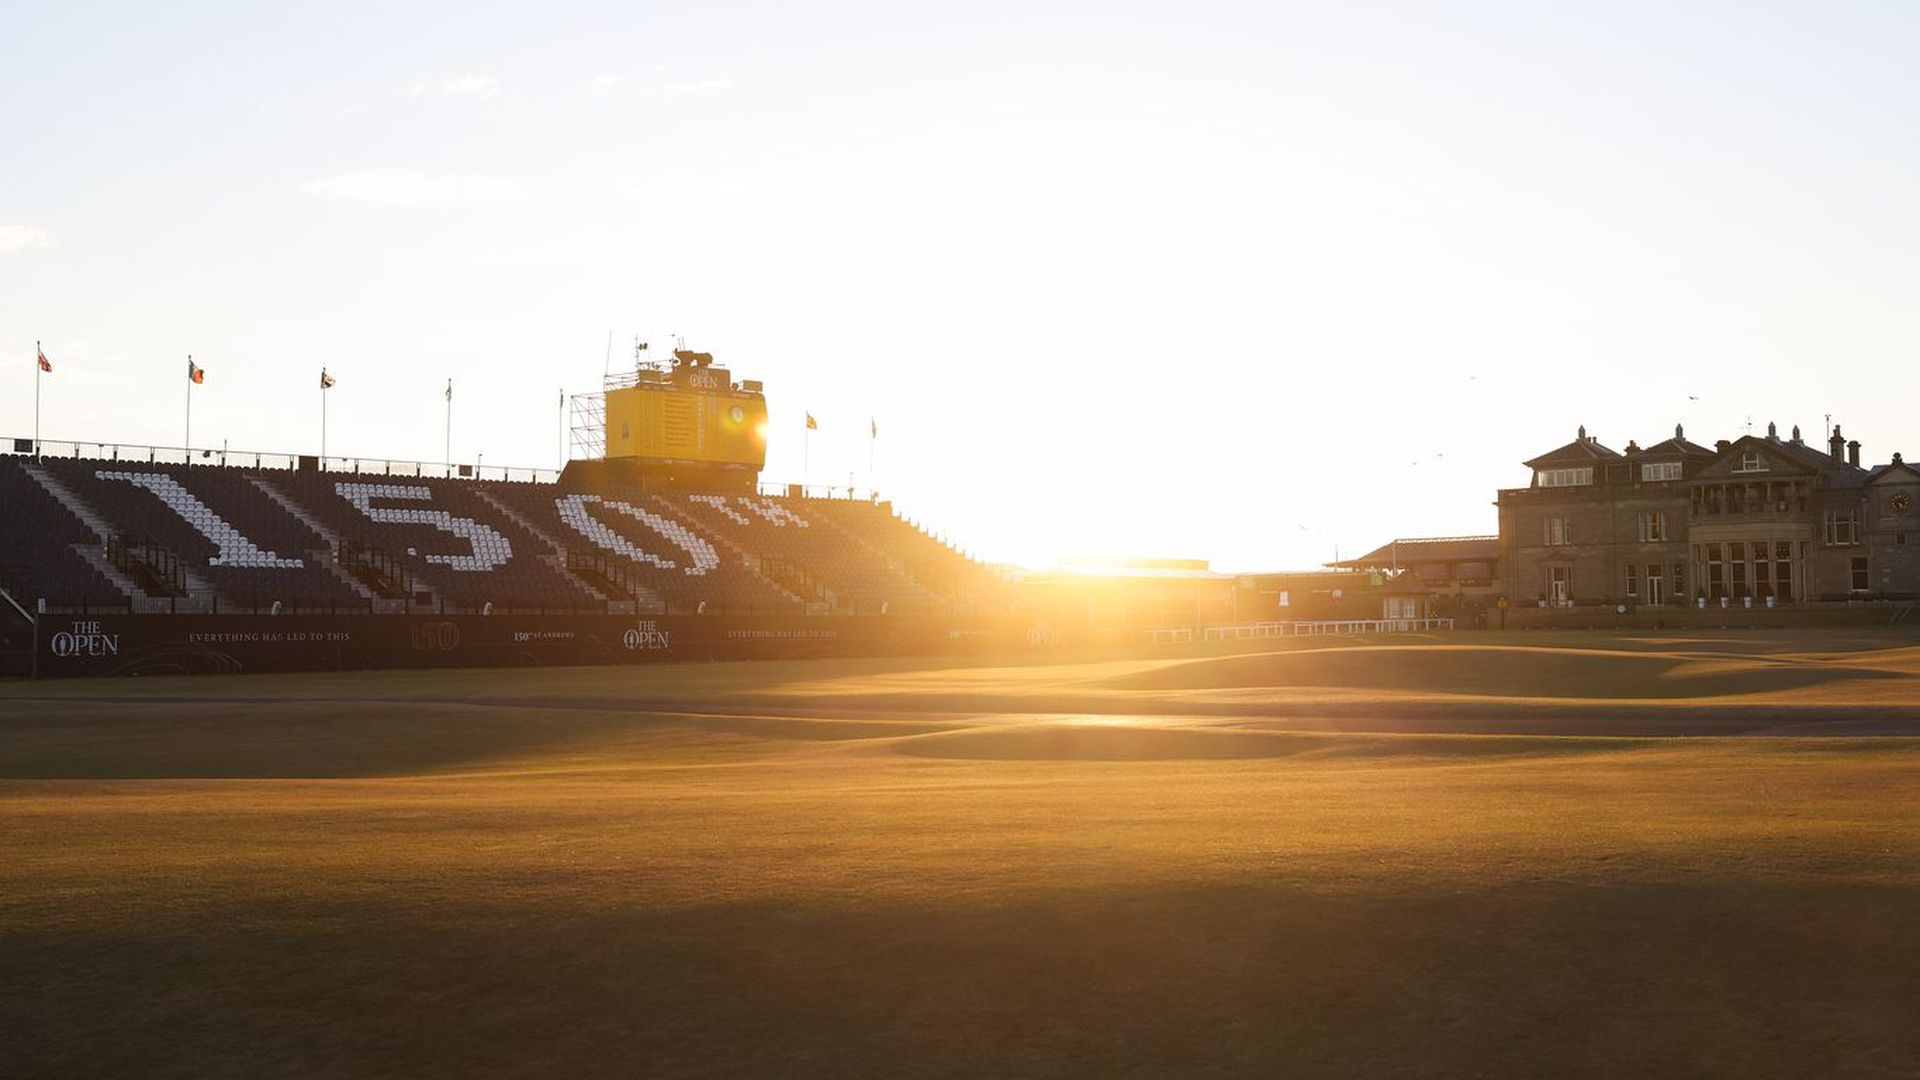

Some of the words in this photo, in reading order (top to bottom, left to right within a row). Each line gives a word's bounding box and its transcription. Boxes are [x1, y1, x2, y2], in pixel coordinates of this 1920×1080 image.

[72, 620, 101, 634] THE
[639, 620, 657, 631] THE
[51, 631, 119, 656] OPEN
[189, 632, 259, 642] EVERYTHING
[262, 632, 284, 642] HAS
[286, 632, 306, 641] LED
[309, 631, 324, 641] TO
[327, 631, 351, 641] THIS
[624, 629, 669, 650] OPEN
